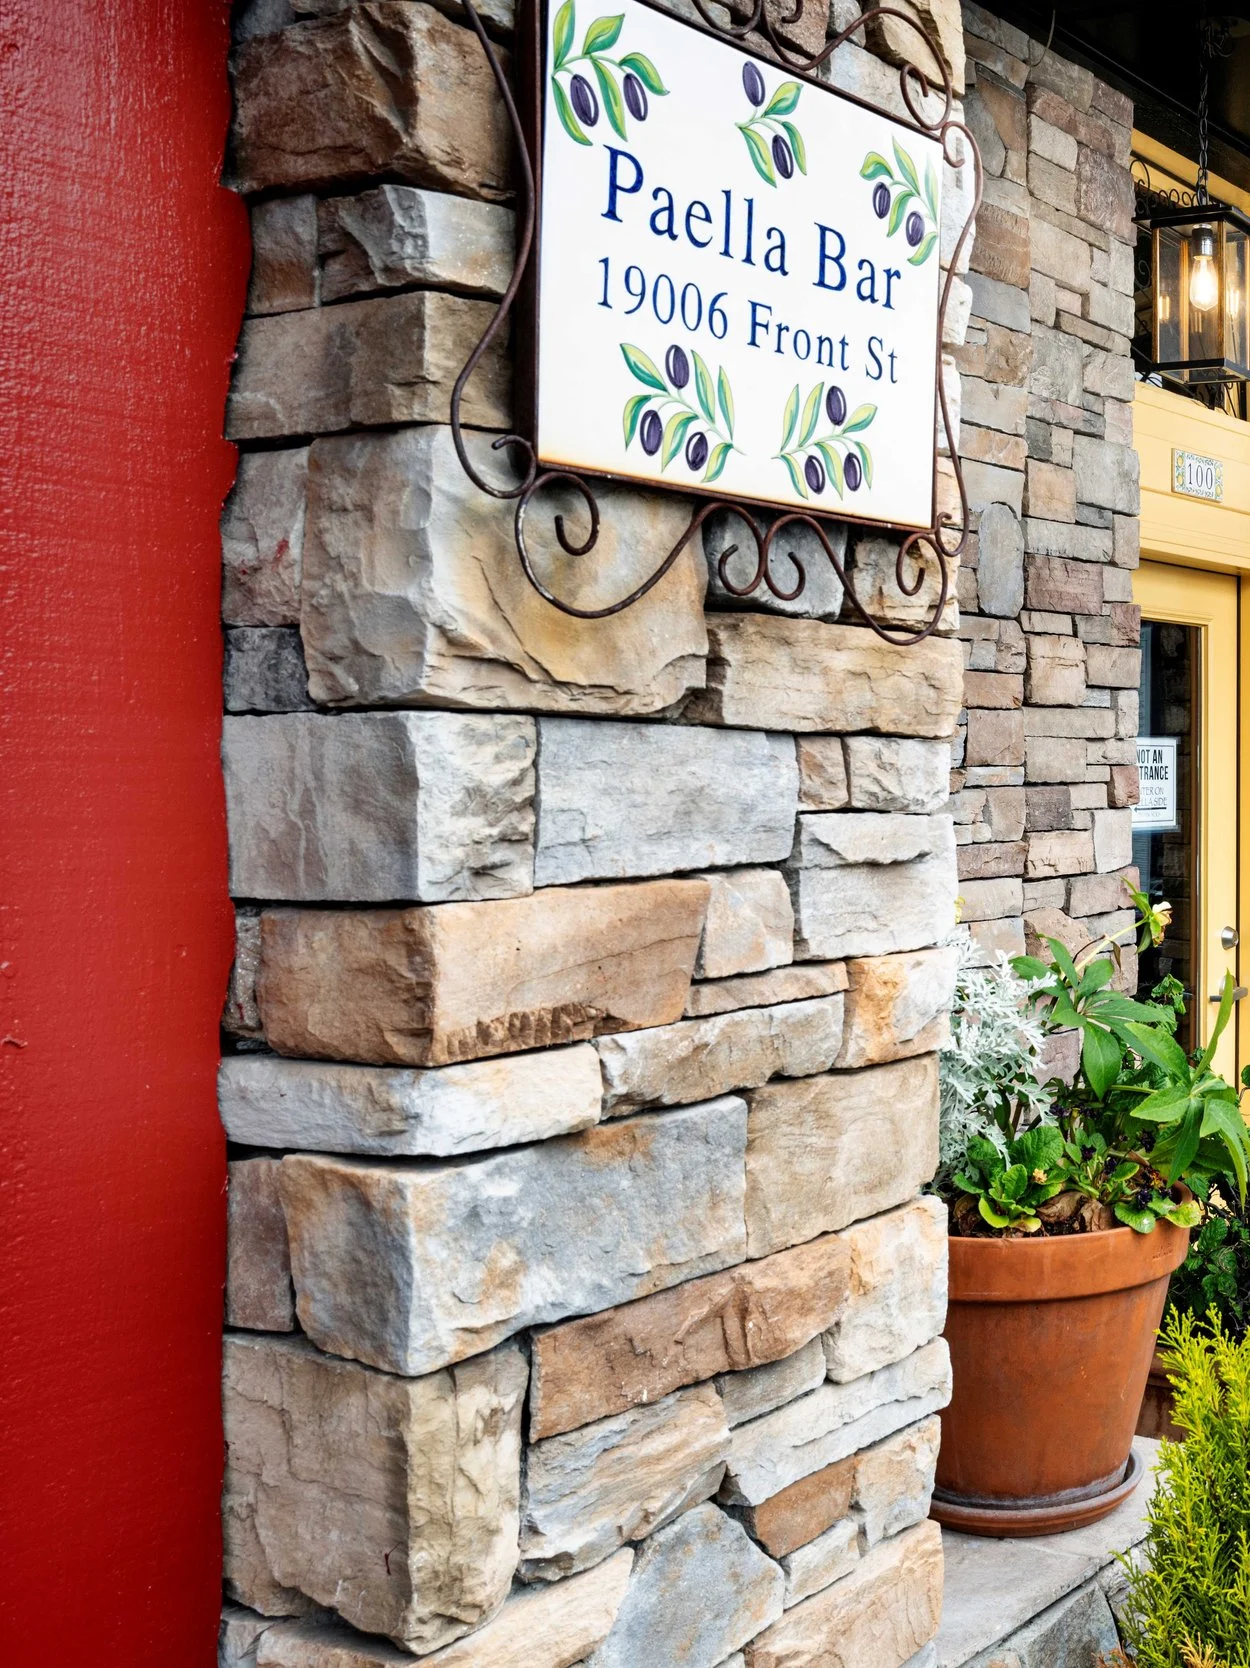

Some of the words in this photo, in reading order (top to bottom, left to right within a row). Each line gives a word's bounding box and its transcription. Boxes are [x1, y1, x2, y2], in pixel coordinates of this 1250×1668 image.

[601, 144, 789, 276] Paella
[812, 222, 902, 310] Bar
[597, 256, 728, 339] 19006
[746, 299, 849, 371] Front
[866, 335, 898, 383] St
[1188, 463, 1213, 490] 100
[1152, 749, 1162, 764] AN
[1139, 766, 1168, 780] TRANCE
